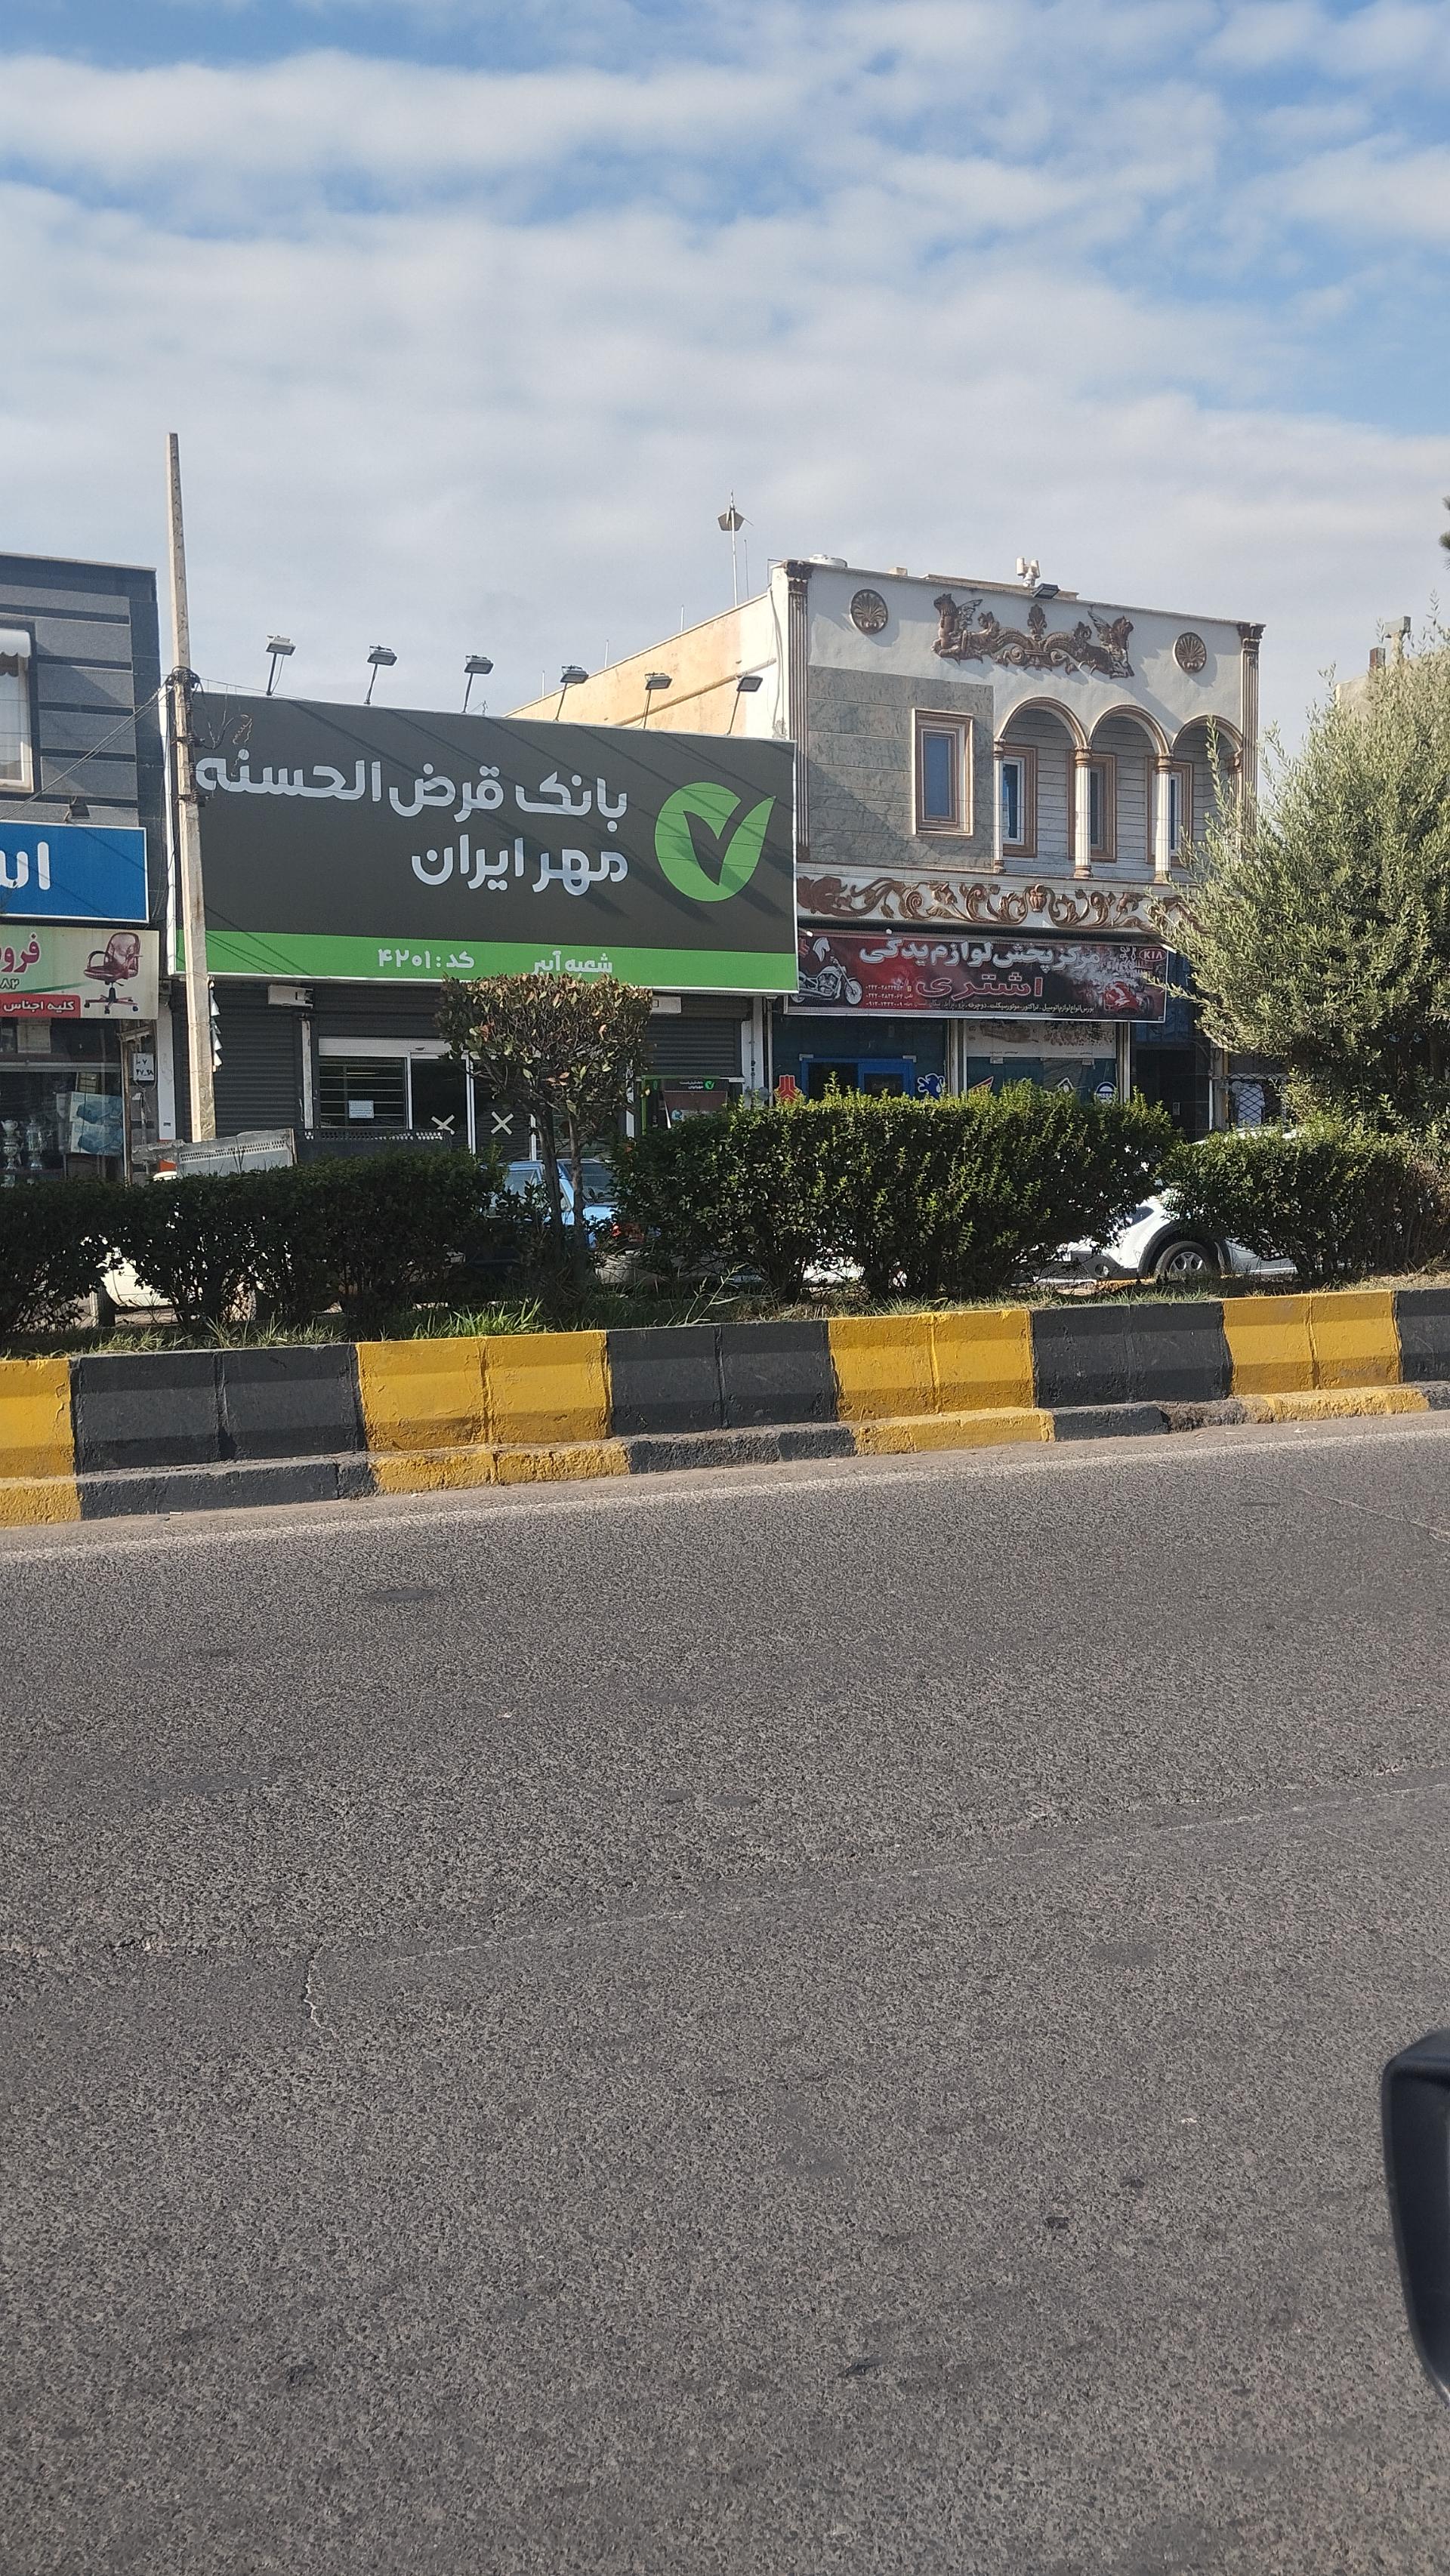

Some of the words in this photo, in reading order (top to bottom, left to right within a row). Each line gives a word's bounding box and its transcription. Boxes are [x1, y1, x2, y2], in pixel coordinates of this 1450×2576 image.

[195, 747, 382, 803] الحسنه
[388, 763, 505, 823] قرض
[515, 770, 628, 832] بانک
[412, 833, 525, 892] ایران
[532, 847, 628, 897] مهر
[565, 952, 613, 974] شعبه
[859, 937, 929, 967] یدکی
[930, 940, 993, 968] لوازم
[992, 943, 1054, 974] پخش
[1052, 946, 1100, 971] مرکز
[1143, 951, 1163, 960] KIA
[916, 972, 1044, 1001] اشتری
[3, 1000, 44, 1013] اجناس
[47, 1000, 75, 1013] کلیه
